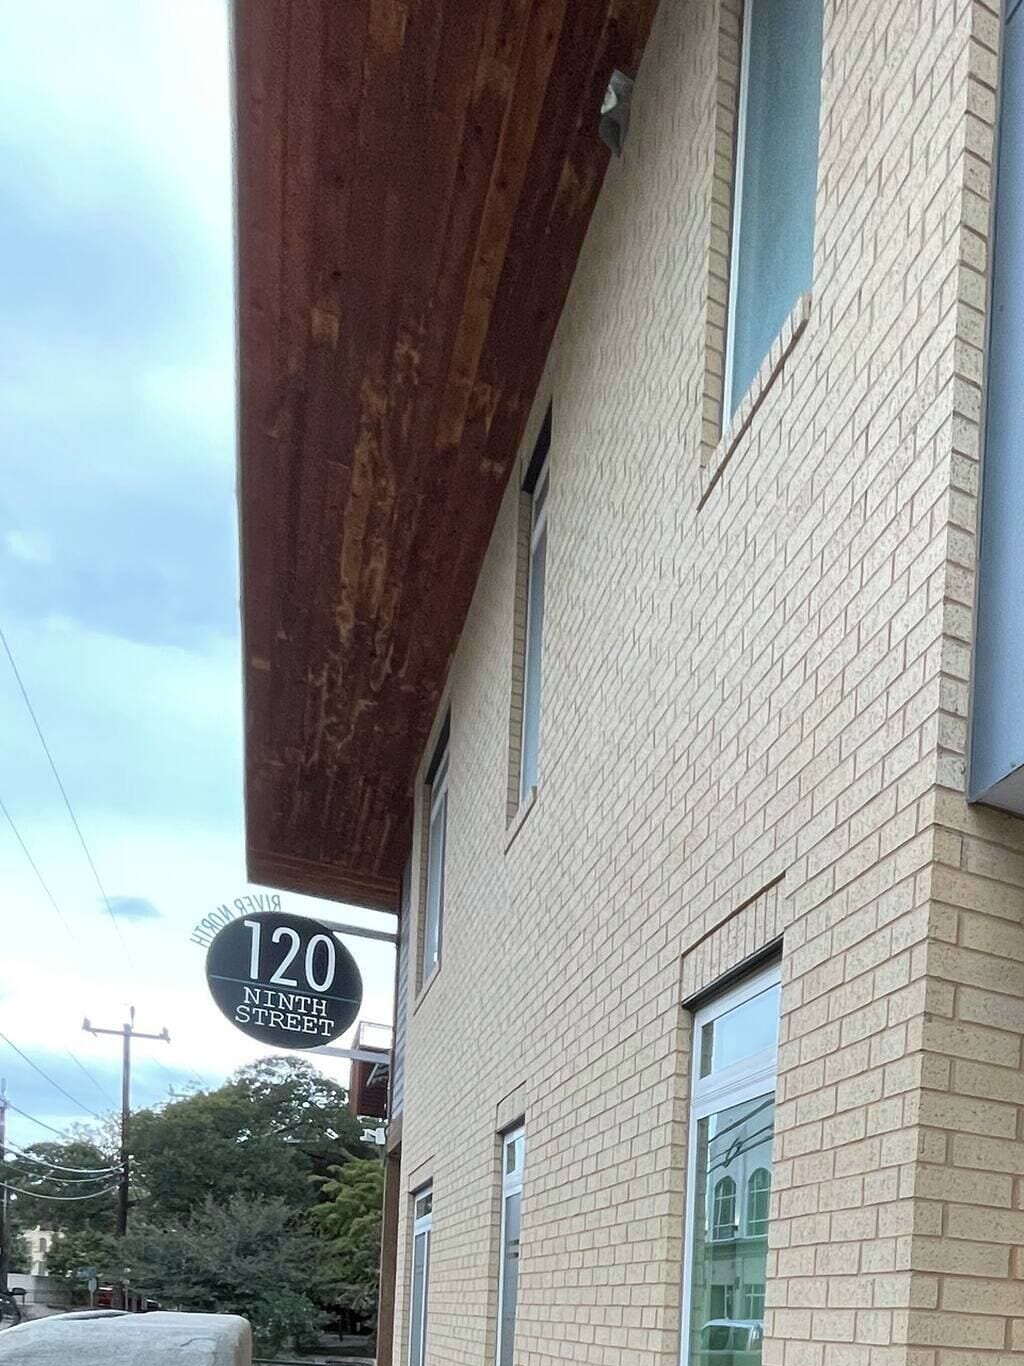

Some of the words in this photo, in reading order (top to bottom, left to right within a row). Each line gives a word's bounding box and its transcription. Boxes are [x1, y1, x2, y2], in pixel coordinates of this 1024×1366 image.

[244, 920, 336, 992] 120
[243, 986, 327, 1016] NINTH
[235, 1005, 334, 1036] STREET
